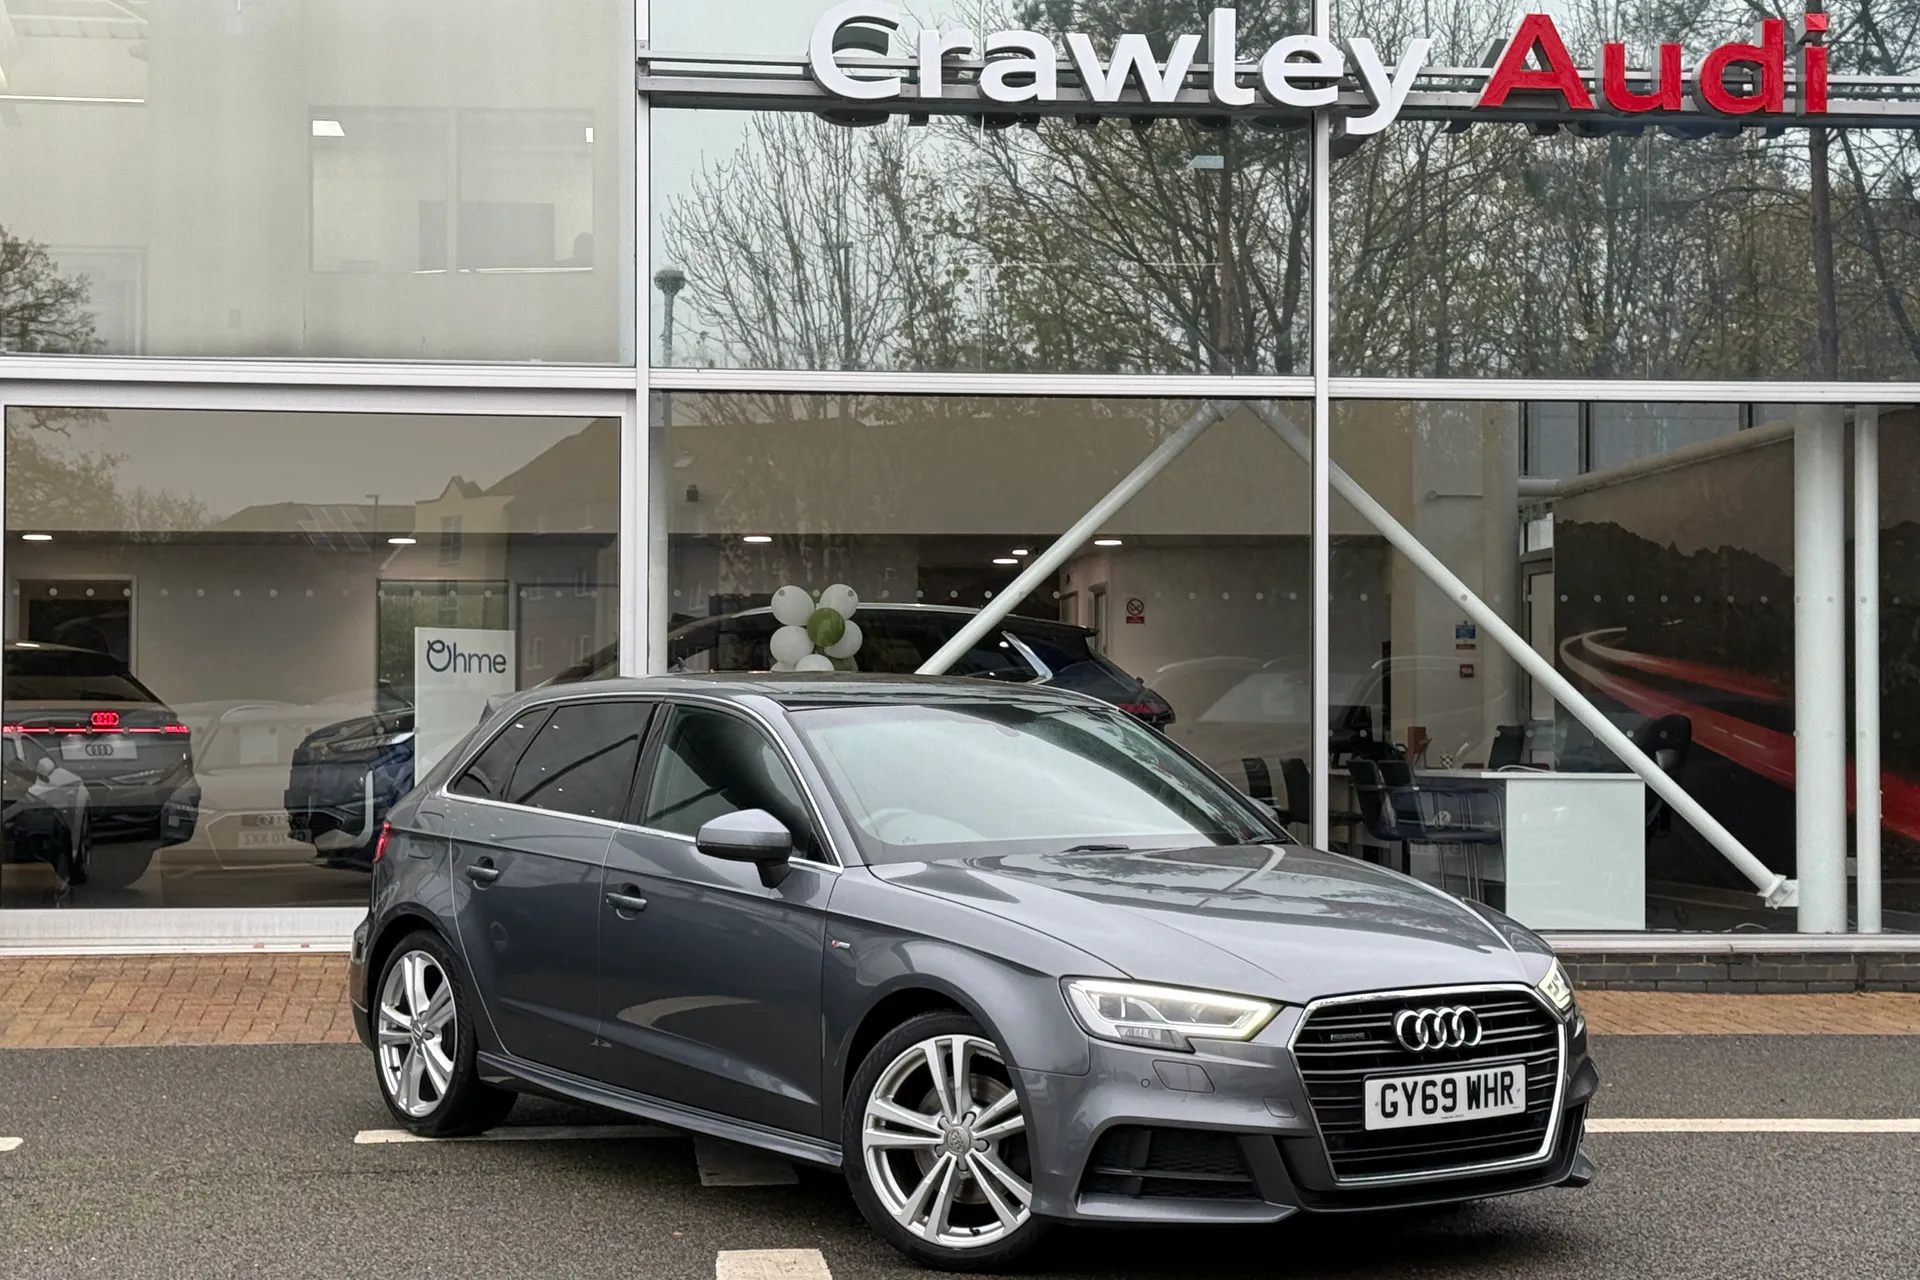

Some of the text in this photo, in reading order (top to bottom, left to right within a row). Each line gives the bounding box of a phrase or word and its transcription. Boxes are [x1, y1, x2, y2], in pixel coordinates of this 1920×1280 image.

[808, 0, 1828, 136] Crawley Audi
[426, 639, 507, 674] Ohme
[1380, 1070, 1515, 1119] GY69 WHR
